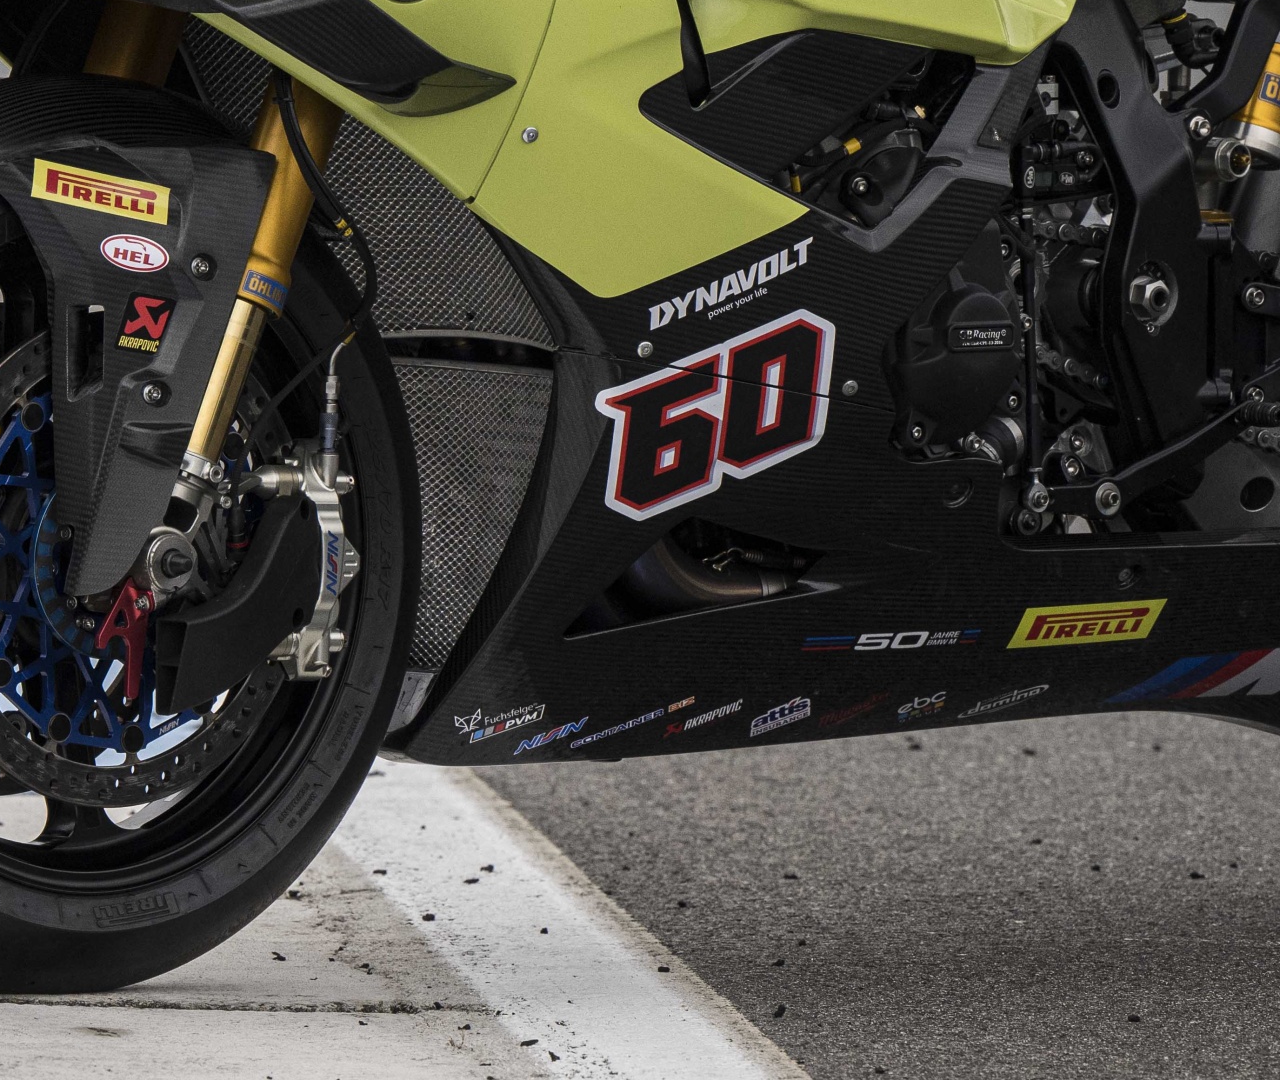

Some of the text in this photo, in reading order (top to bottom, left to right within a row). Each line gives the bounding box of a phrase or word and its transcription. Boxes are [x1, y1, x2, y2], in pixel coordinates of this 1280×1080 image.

[45, 168, 158, 216] PIRELLI
[113, 247, 154, 266] HEL
[648, 236, 814, 331] DYNAVOLT
[707, 286, 768, 320] power your life
[603, 316, 826, 514] 60
[930, 631, 961, 640] JAHRE
[1024, 606, 1152, 641] PIRELLI
[854, 631, 930, 651] 50
[926, 638, 949, 646] BMW
[751, 696, 811, 728] attis
[897, 691, 947, 714] ebc
[967, 689, 1041, 715] domino
[505, 711, 538, 729] PVM
[570, 696, 696, 748] CONTAINER BIZ
[92, 890, 180, 928] PIRELLI
